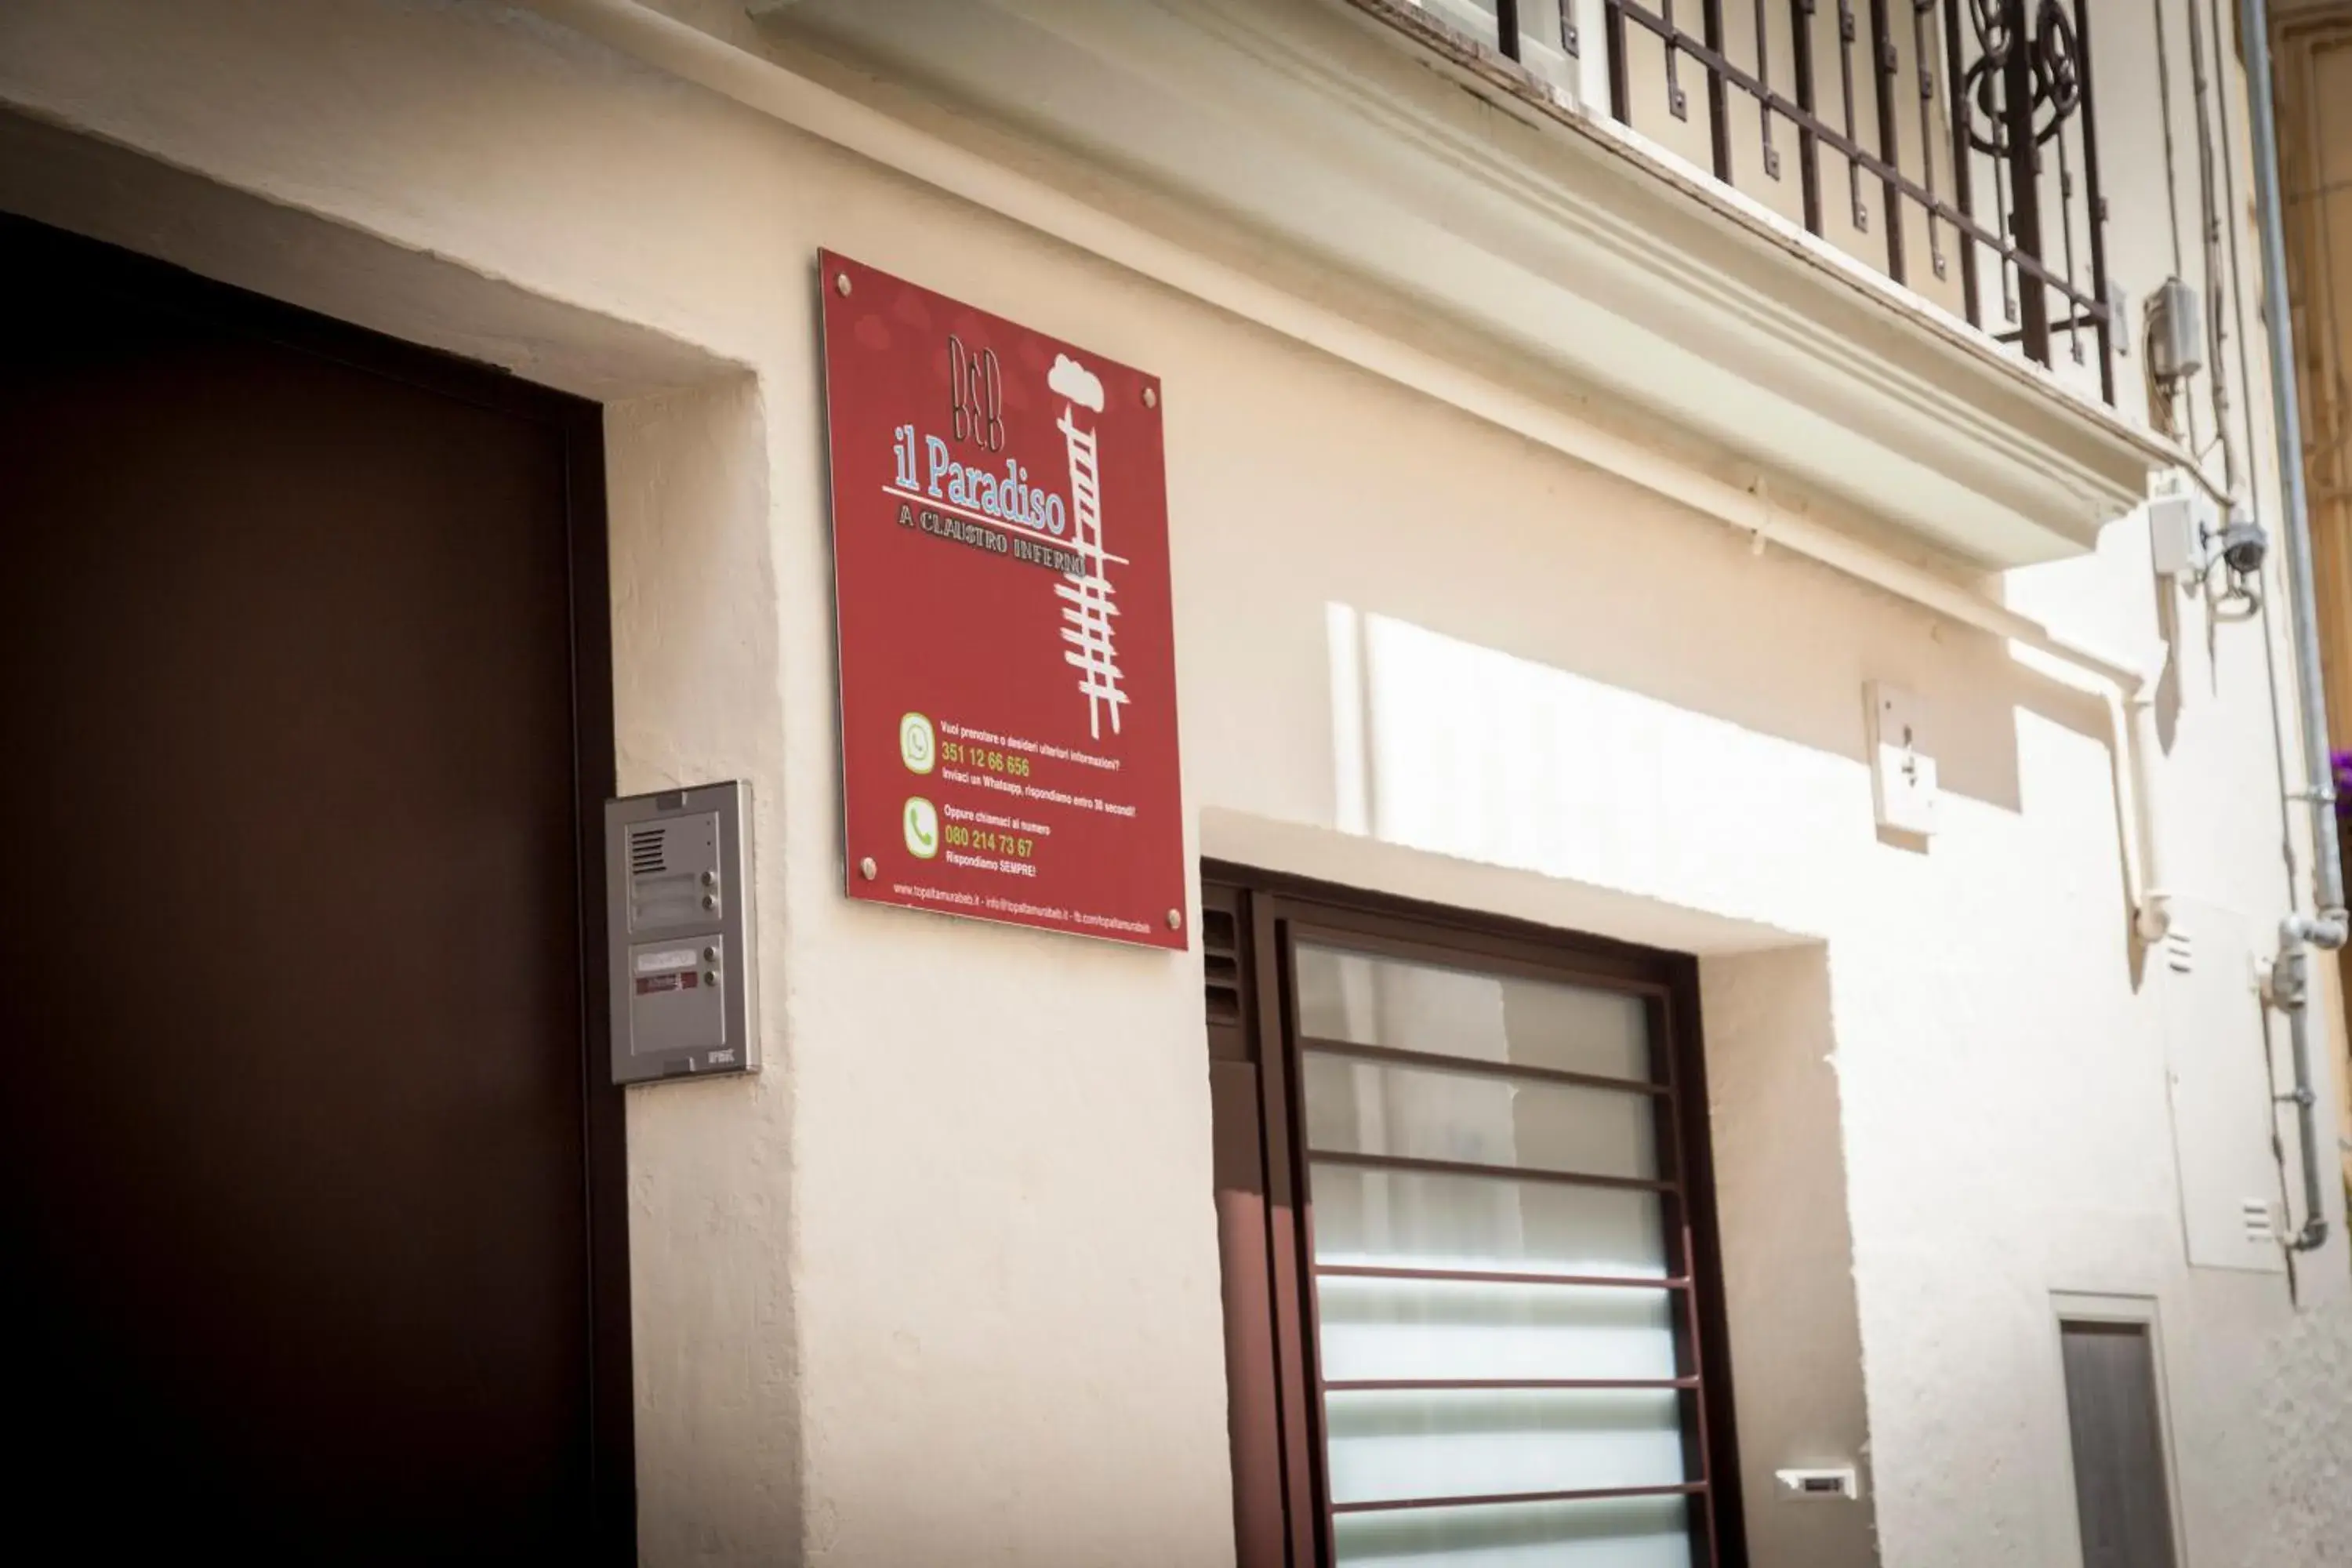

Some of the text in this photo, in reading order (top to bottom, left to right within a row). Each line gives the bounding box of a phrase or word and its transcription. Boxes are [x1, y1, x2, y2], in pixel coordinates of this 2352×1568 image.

[894, 424, 1065, 535] il Paradiso
[899, 505, 1087, 579] A CLAUSTRO INFERNO
[941, 720, 1120, 771] Vuoi prenotare o desideri ulteriori informazioni?
[942, 741, 1029, 778] 351 12 66 656
[942, 767, 969, 784] Inviaci
[971, 775, 982, 786] un
[1025, 784, 1073, 805] rispondiamo
[1074, 796, 1094, 809] entro
[944, 804, 1051, 837] Oppure chiamaci al numero
[946, 825, 1033, 858] 080 214 73 67
[946, 851, 1036, 877] Rispondiamo SEMPRE!
